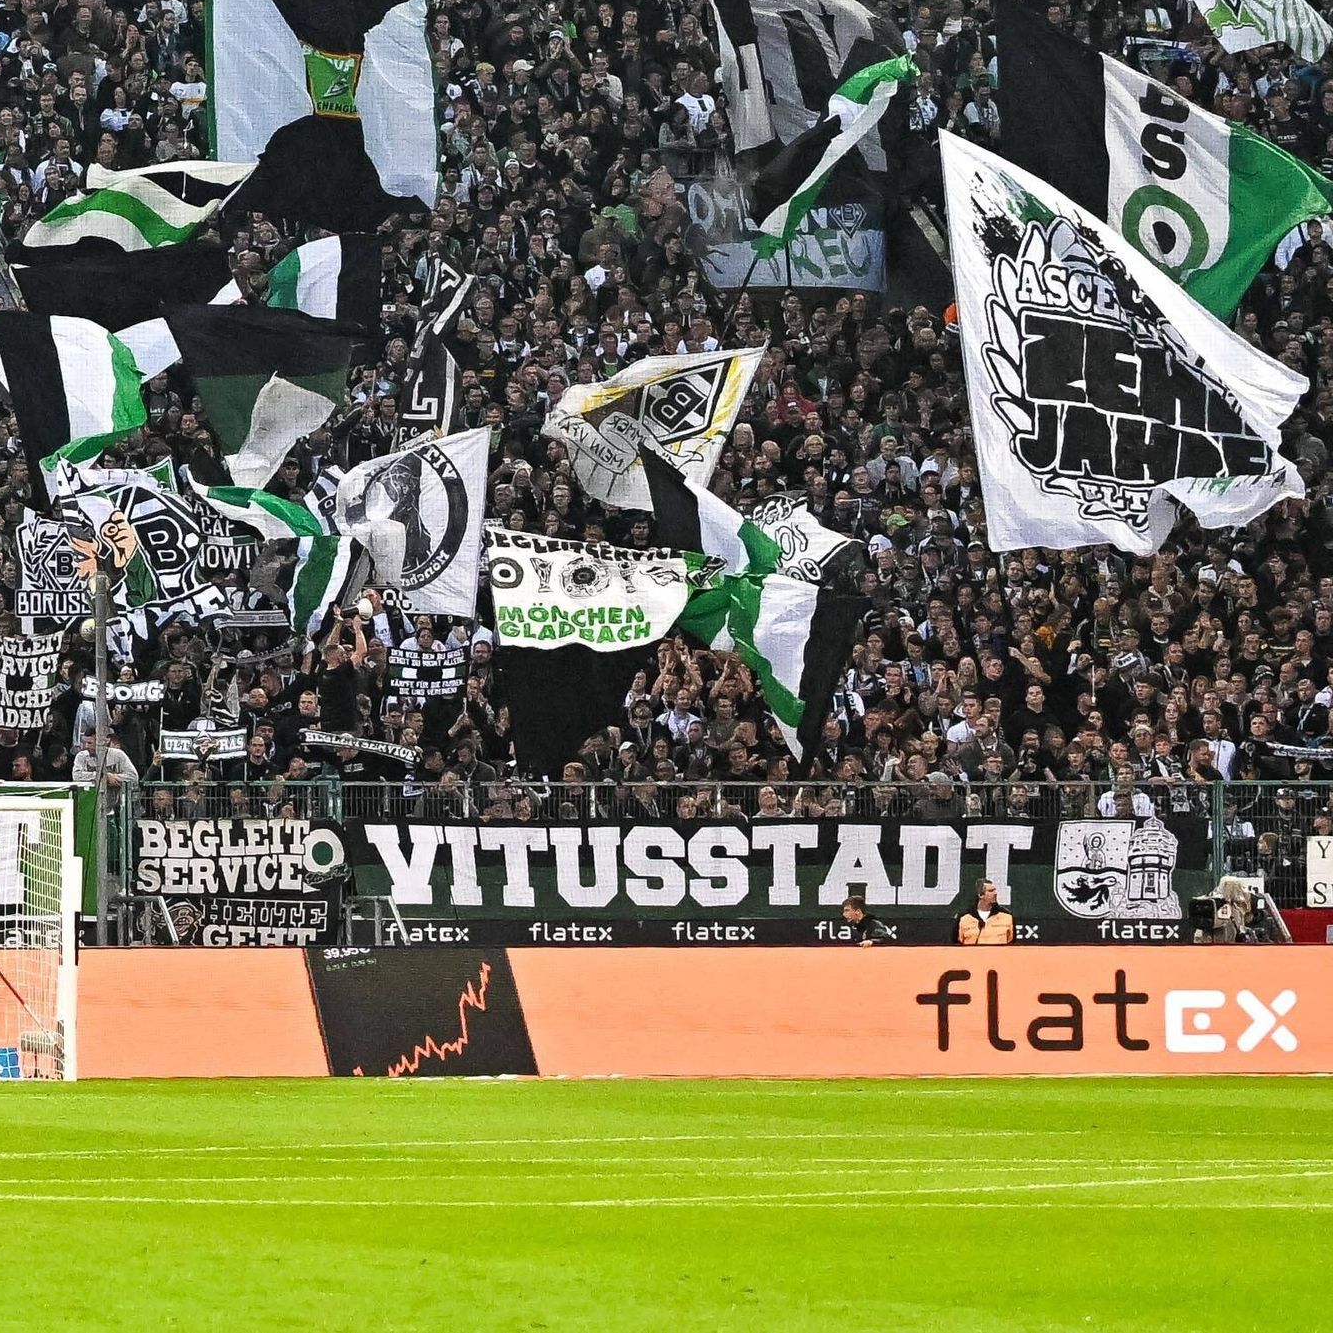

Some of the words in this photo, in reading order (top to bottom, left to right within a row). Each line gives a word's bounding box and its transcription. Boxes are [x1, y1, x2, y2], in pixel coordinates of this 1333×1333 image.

[499, 602, 646, 628] MÖNCHEN
[499, 621, 652, 644] GLADBACH
[136, 818, 311, 858] BEGLEIT
[136, 854, 304, 894] SERVICE
[364, 823, 1034, 908] VITUSSTADT
[201, 899, 328, 932] HEUTE
[202, 924, 317, 947] GEHT
